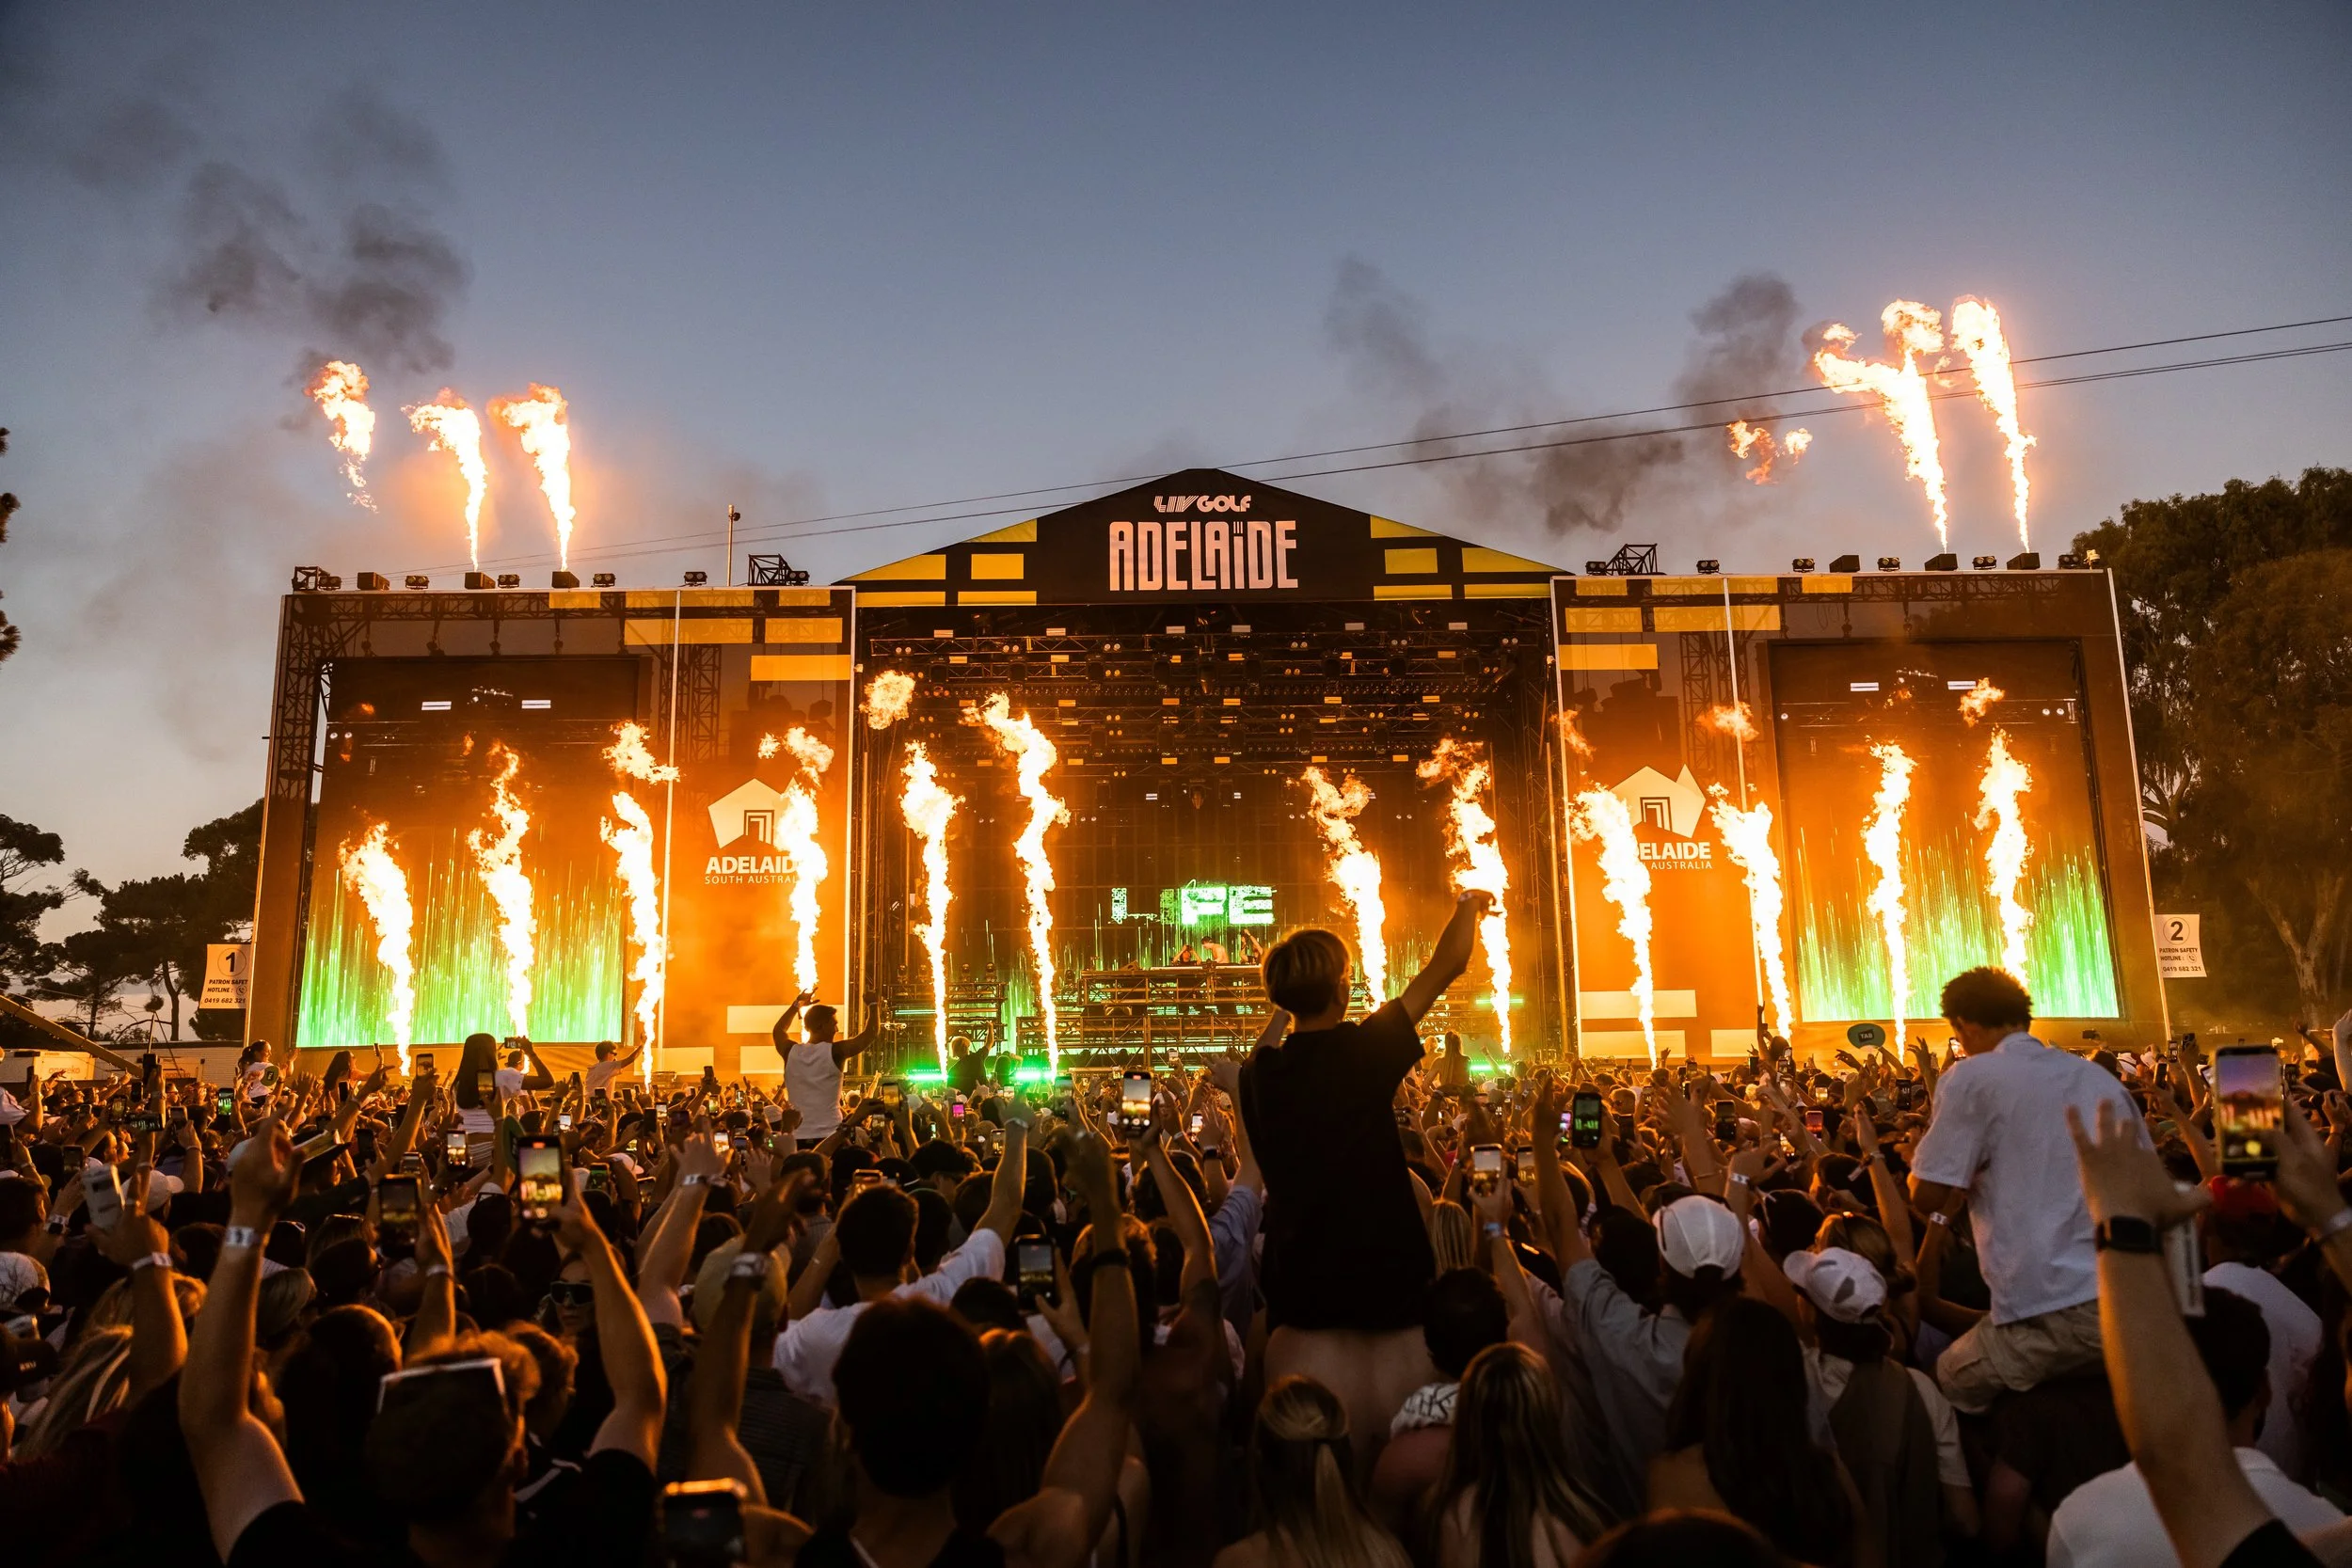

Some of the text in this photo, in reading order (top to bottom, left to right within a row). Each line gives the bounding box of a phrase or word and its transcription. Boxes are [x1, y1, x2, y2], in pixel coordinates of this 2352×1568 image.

[1639, 842, 1711, 860] ELAIDE
[705, 856, 798, 875] ADELAID
[1650, 861, 1712, 870] AUSTRALIA
[705, 876, 743, 884] SOUTH
[747, 875, 799, 884] AUSTRAL
[2170, 921, 2184, 941] 2
[226, 952, 235, 972] 1
